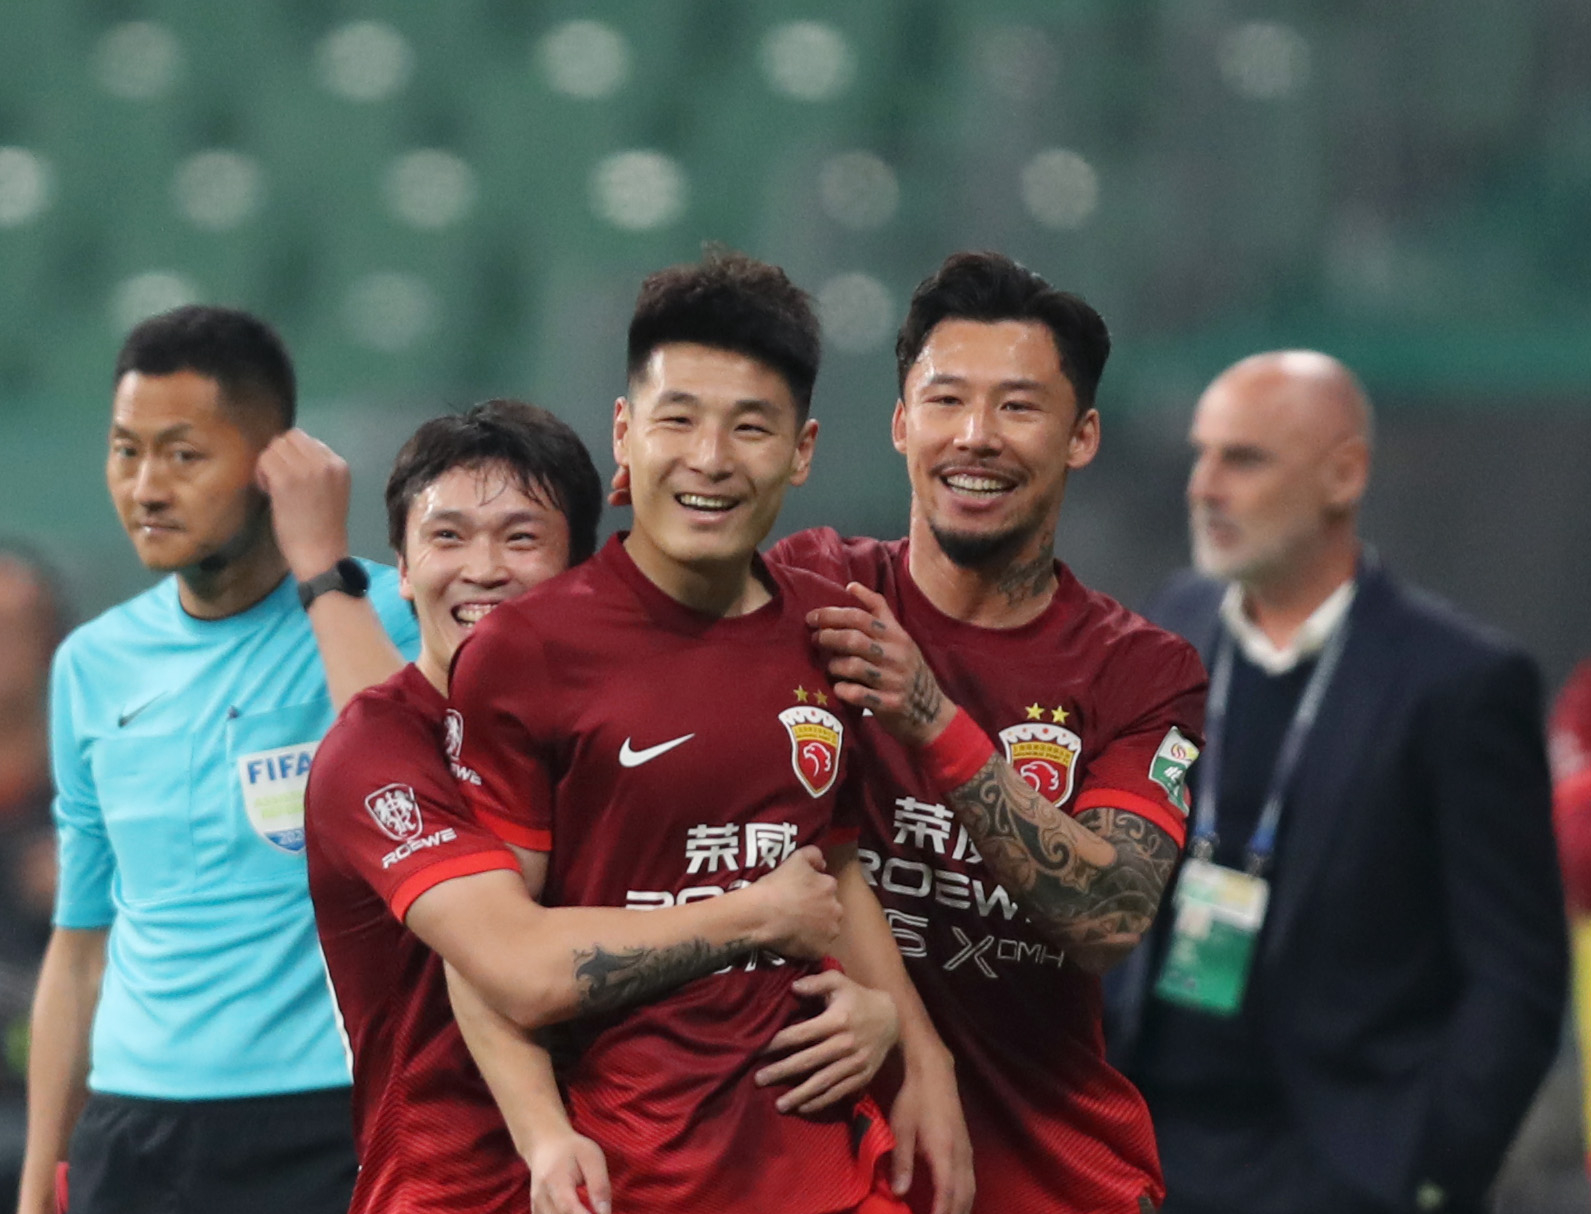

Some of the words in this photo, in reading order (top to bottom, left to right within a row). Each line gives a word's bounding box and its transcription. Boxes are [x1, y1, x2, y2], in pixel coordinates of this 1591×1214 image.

[247, 751, 312, 785] FIFA
[381, 827, 457, 870] ROEWE
[686, 822, 798, 875] 荣威
[858, 848, 1031, 924] ROEW
